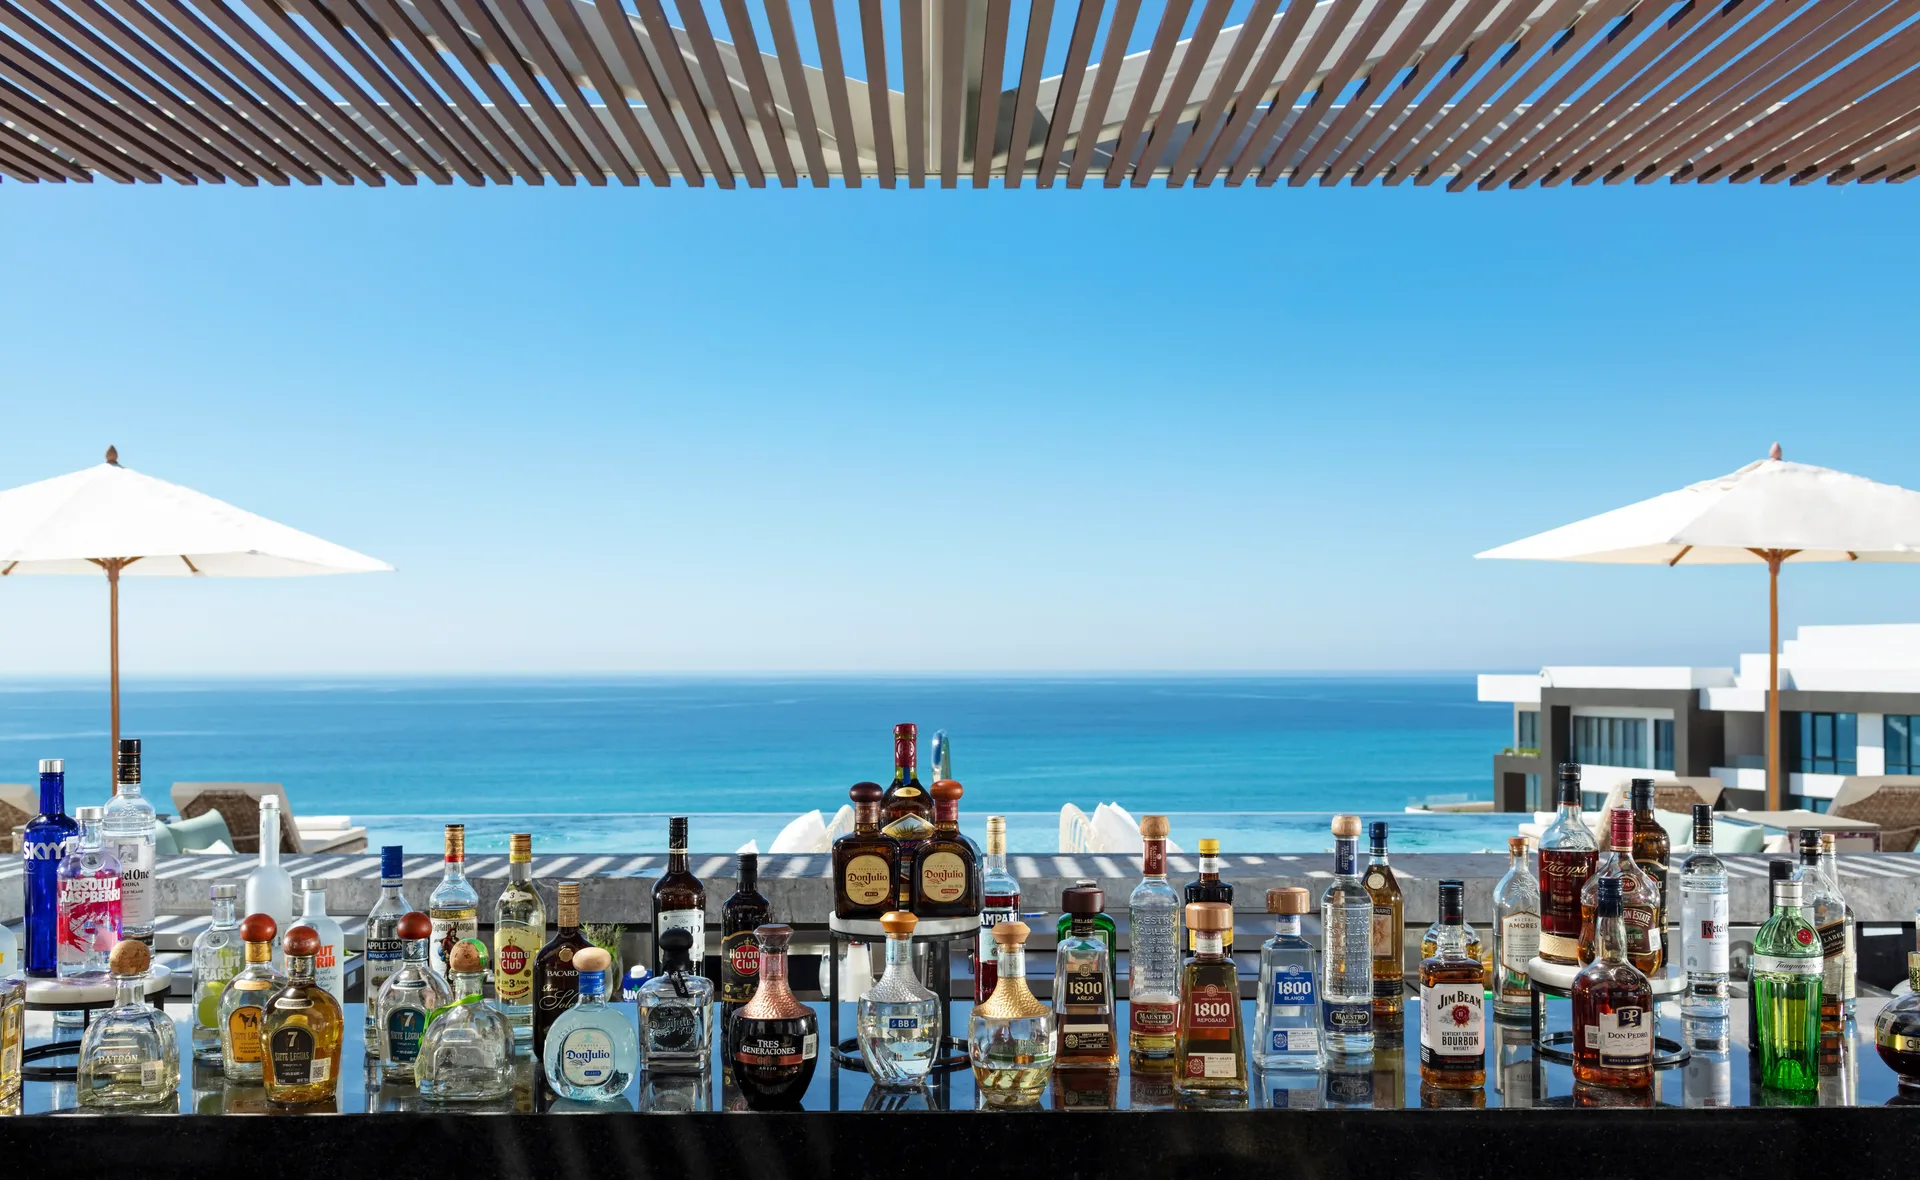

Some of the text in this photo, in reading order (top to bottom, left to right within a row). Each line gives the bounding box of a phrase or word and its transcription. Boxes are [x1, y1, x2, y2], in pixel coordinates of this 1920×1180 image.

[24, 841, 66, 860] SKYY
[133, 868, 149, 880] One
[66, 877, 118, 891] ABSOLUT
[61, 888, 120, 902] RASPBERRI
[510, 891, 516, 899] 3
[980, 912, 1018, 926] AMPARI
[1632, 911, 1652, 923] ESTATE
[1823, 931, 1845, 943] LABEL
[500, 951, 531, 959] avana
[729, 948, 760, 959] Havan
[501, 959, 522, 970] Club
[736, 959, 758, 969] Club
[199, 968, 234, 980] PEARS
[509, 979, 516, 988] 3
[1068, 981, 1102, 995] 1800
[1277, 981, 1312, 995] 1800
[540, 989, 577, 1010] Sole
[1438, 990, 1482, 1010] JIM BEAM
[1139, 1012, 1171, 1020] MAESTRO
[1193, 1003, 1231, 1017] 1800
[404, 1012, 414, 1027] 7
[287, 1031, 298, 1047] 7
[757, 1039, 779, 1048] TRES
[1442, 1037, 1479, 1046] BOURBON
[742, 1044, 796, 1056] GENERACIONES
[98, 1055, 138, 1065] PATRÓN
